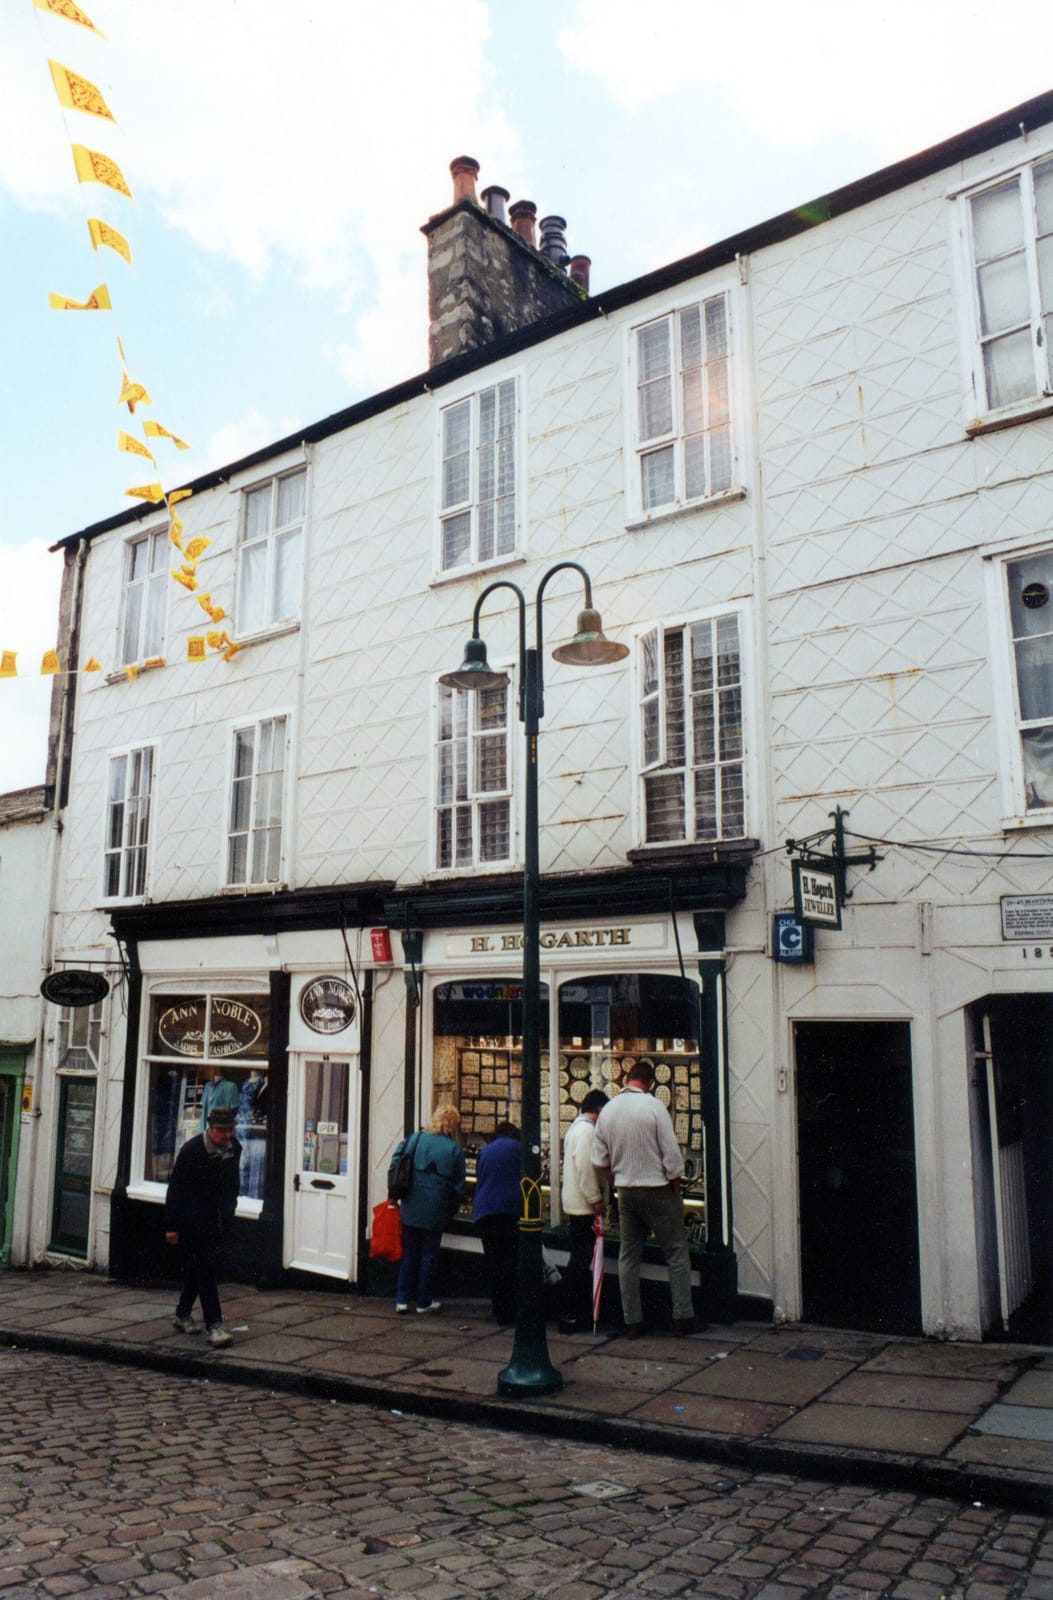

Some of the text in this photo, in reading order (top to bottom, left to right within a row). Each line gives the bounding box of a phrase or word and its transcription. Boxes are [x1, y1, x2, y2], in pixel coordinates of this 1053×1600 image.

[804, 898, 835, 917] JEWELLER
[470, 928, 631, 952] H. HGARTH
[171, 1000, 253, 1027] ANN NOBLE
[319, 1123, 336, 1132] OPEN
